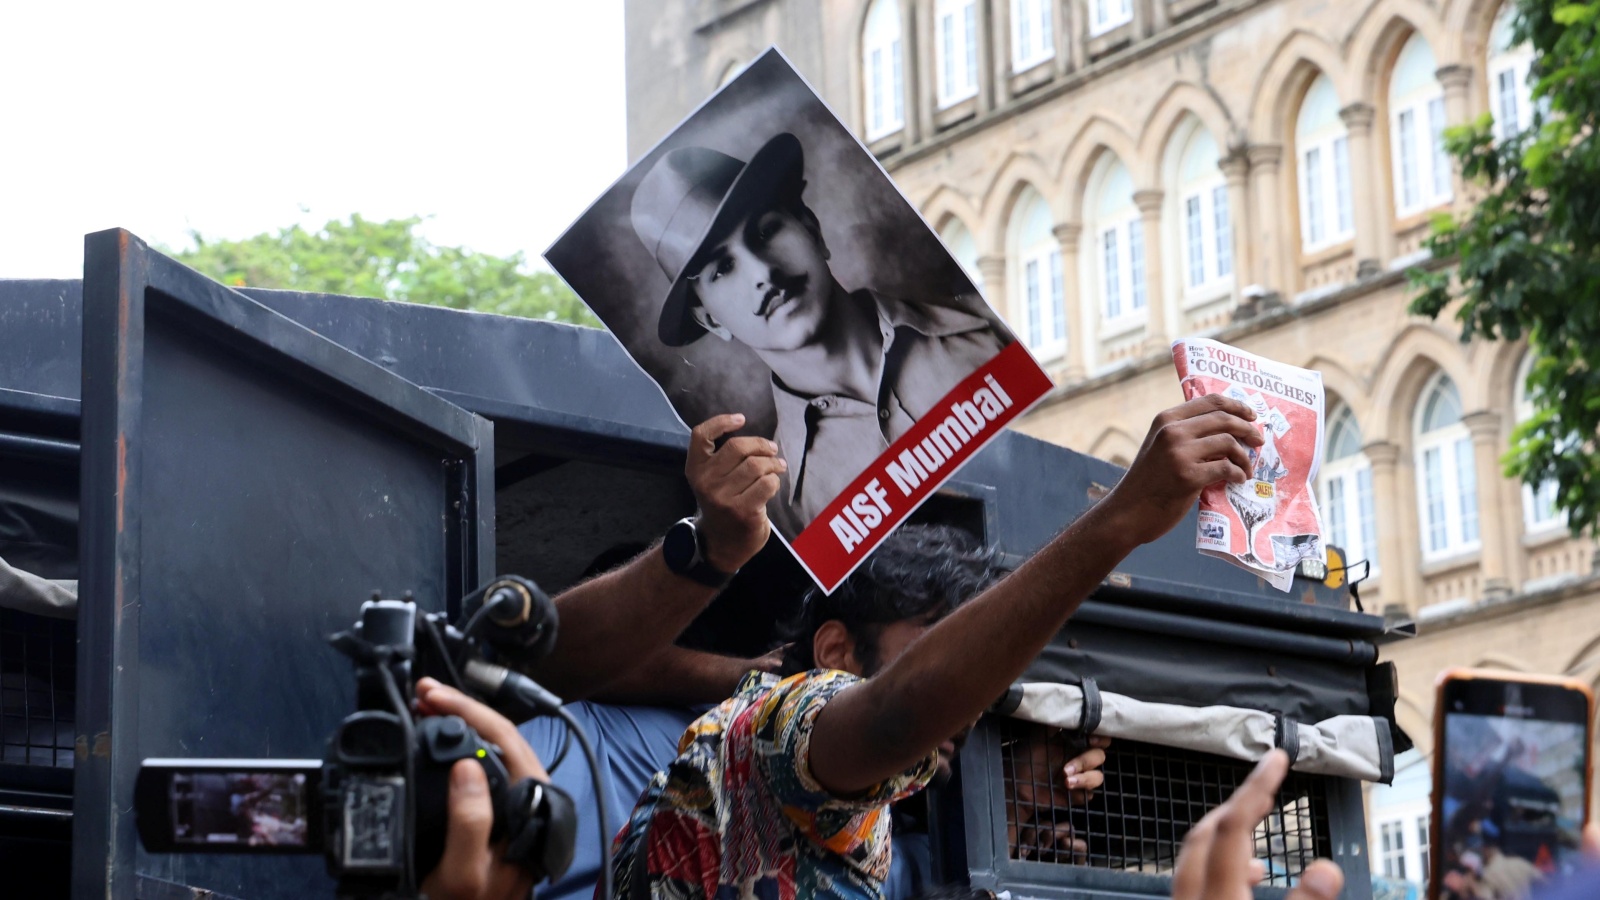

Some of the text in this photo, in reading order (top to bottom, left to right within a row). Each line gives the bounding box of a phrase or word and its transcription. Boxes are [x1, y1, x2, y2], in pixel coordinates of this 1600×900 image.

[1190, 358, 1317, 406] ‘COCKROACHES’
[1205, 346, 1258, 372] YOUTH
[1259, 368, 1283, 382] became
[828, 373, 1014, 554] AISF Mumbai
